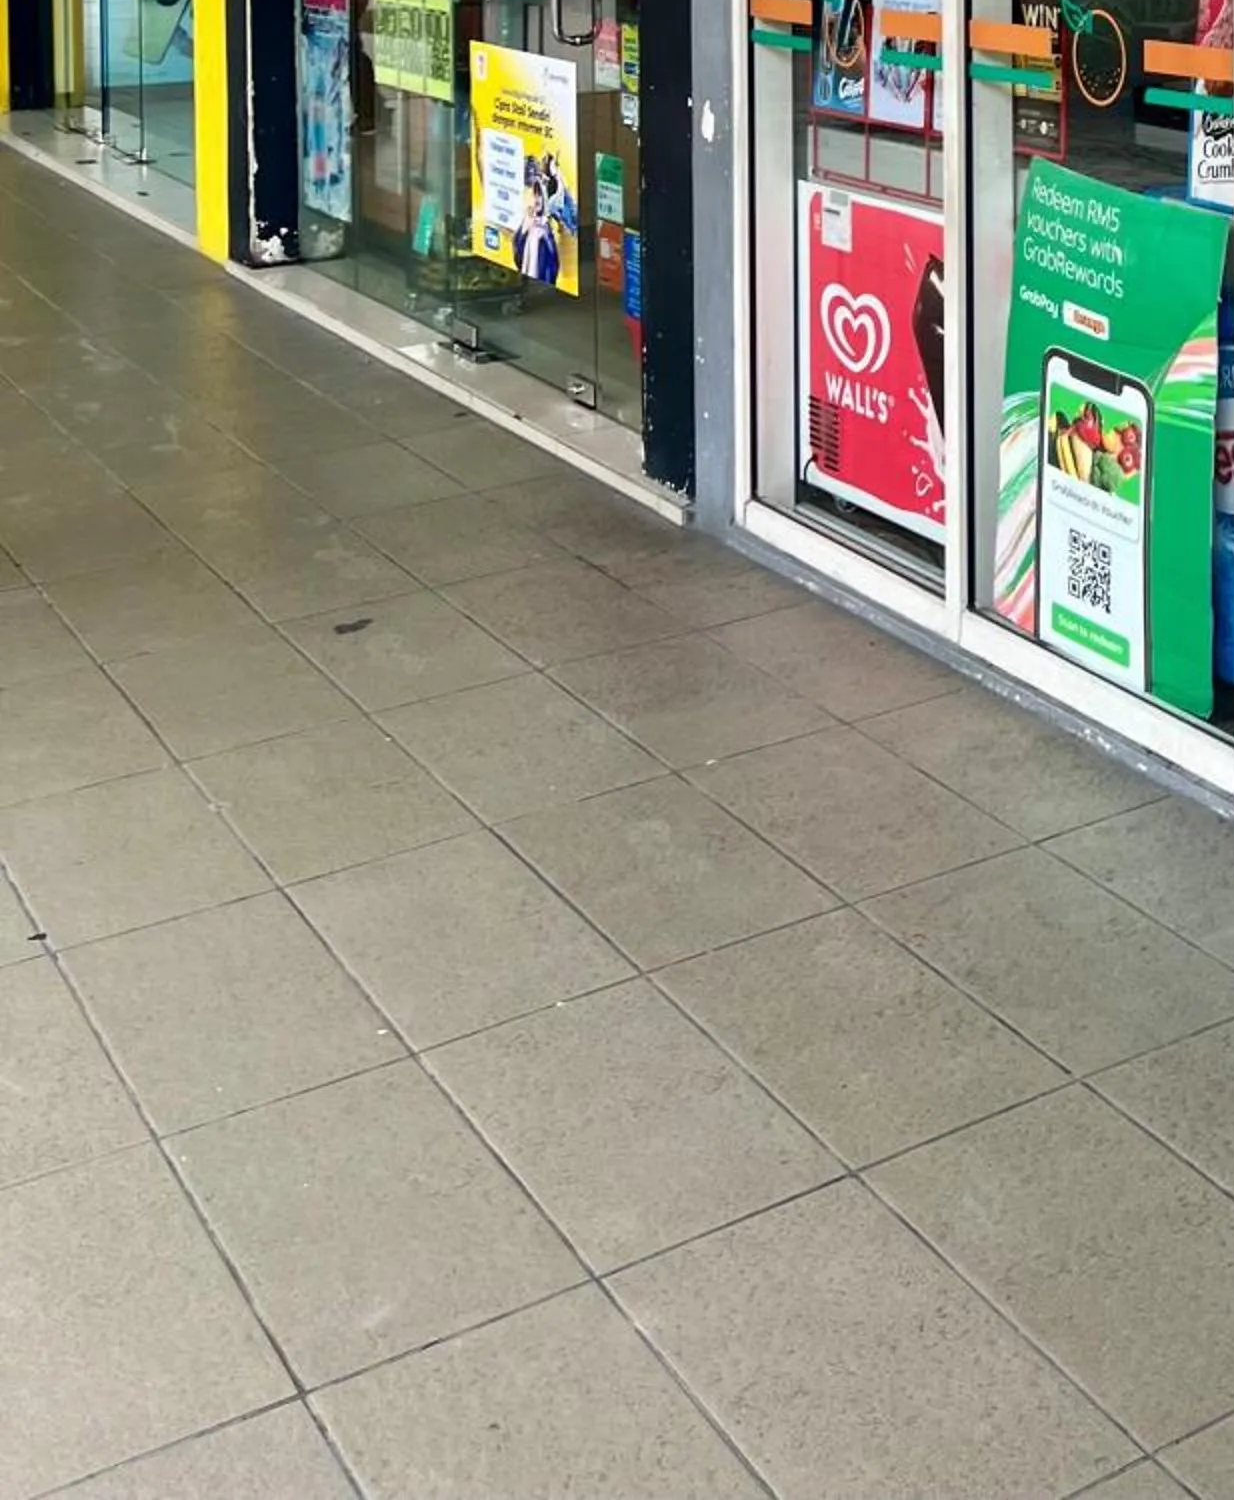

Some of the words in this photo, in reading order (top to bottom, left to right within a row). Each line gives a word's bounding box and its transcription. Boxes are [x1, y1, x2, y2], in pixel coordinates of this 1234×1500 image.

[1031, 176, 1085, 219] Redeem
[1087, 199, 1121, 233] RM5
[1023, 236, 1124, 298] GrabRewards
[1026, 211, 1087, 252] vouchers
[1090, 238, 1123, 267] with
[1019, 283, 1059, 319] GrabPay
[825, 371, 889, 424] WALL'S
